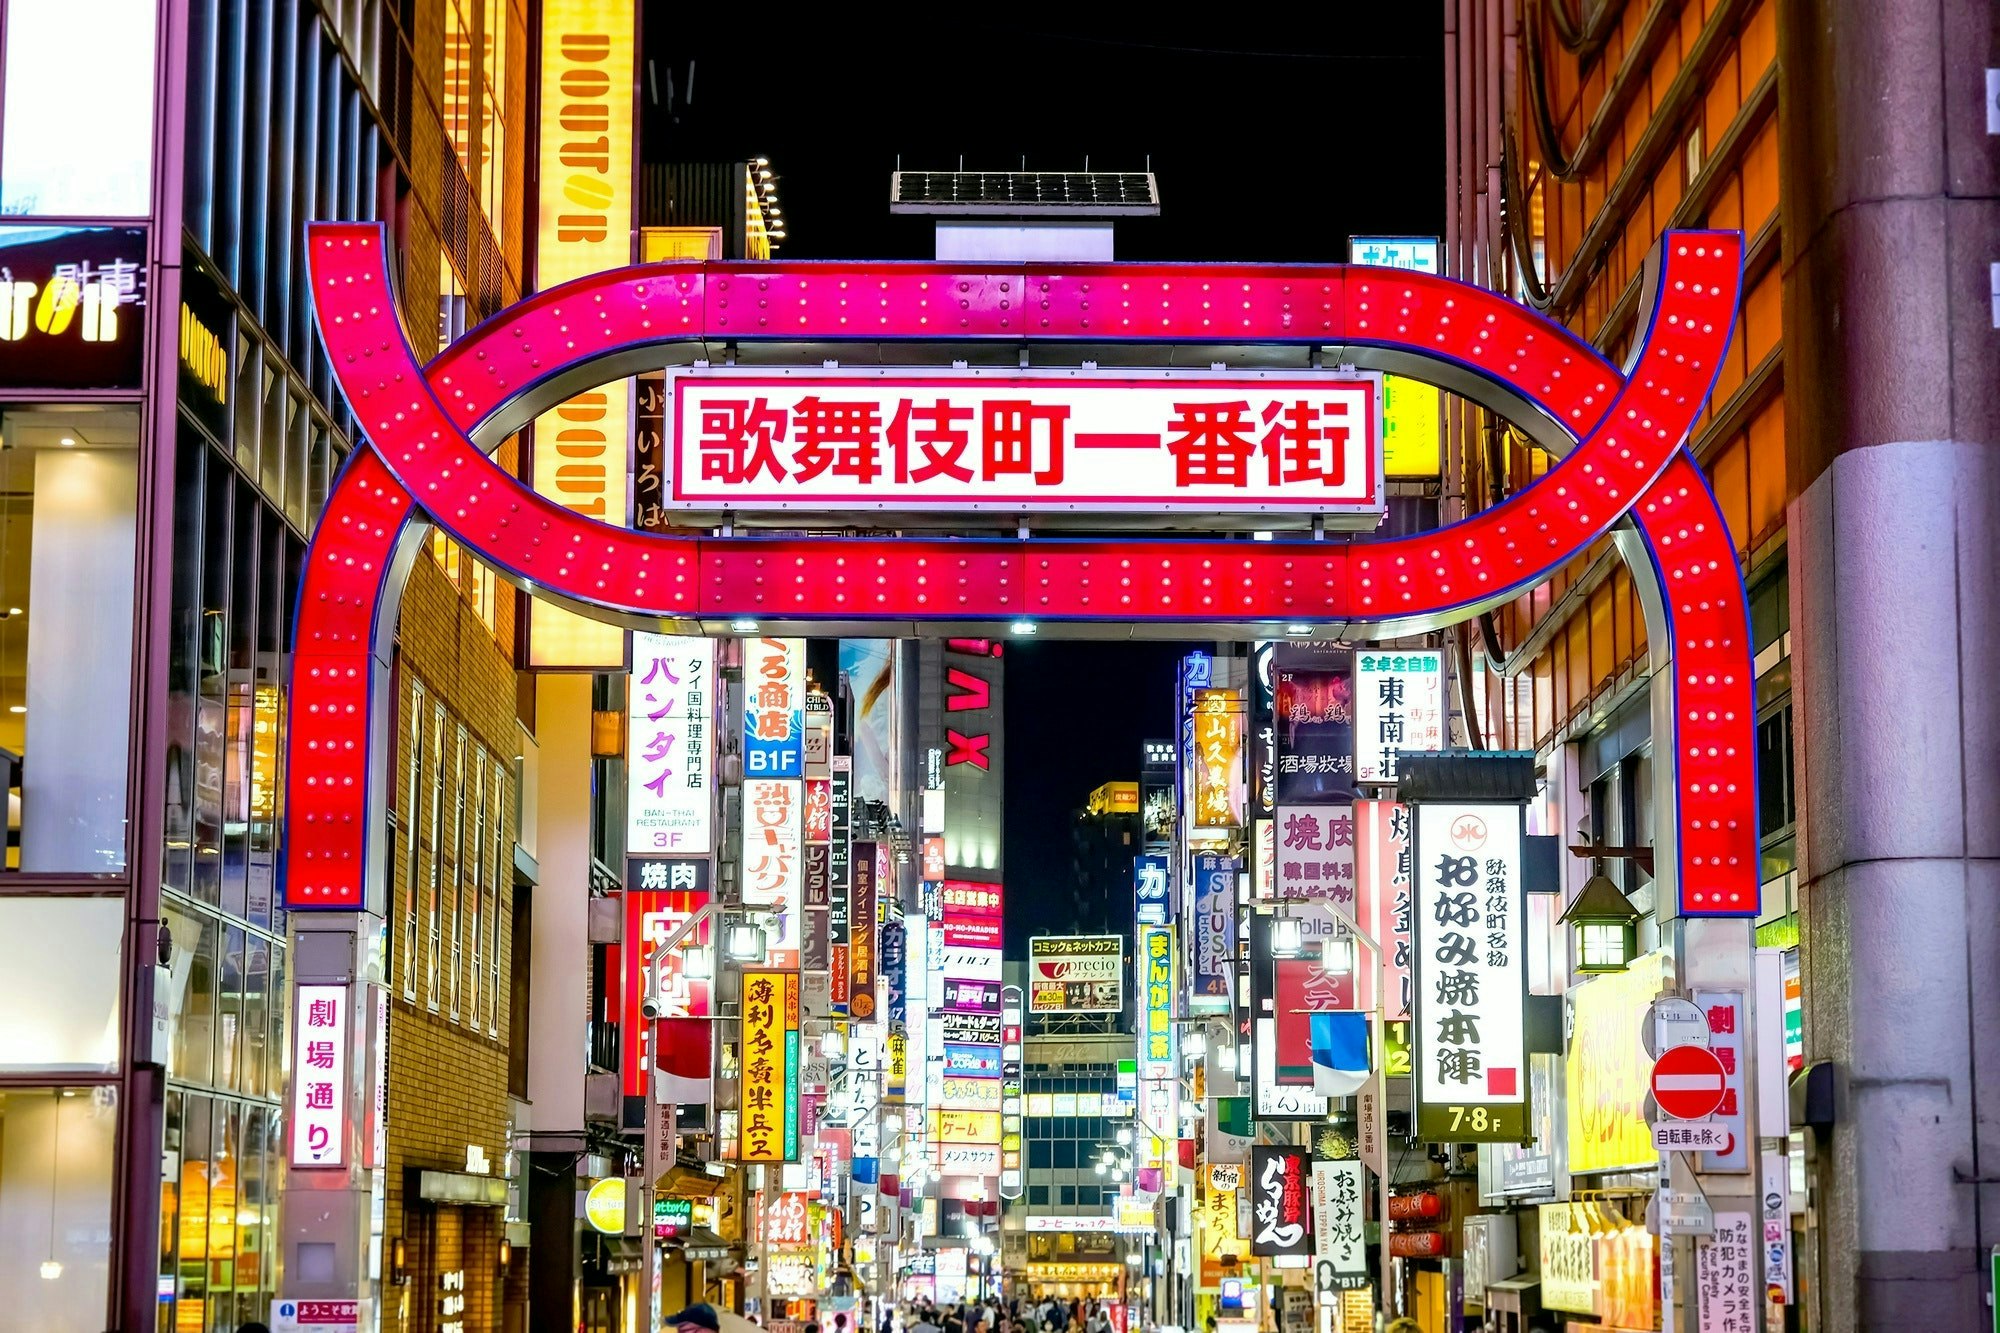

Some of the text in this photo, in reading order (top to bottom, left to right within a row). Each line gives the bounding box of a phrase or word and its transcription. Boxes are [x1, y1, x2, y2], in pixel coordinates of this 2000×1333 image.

[559, 34, 614, 242] DOUTOR
[700, 396, 1349, 487] 歌舞伎町一番街
[1281, 674, 1293, 682] 2F
[1361, 656, 1438, 672] 全卓全自動
[640, 658, 680, 798] バンタイ
[687, 659, 703, 788] タイ国料理専門店
[1379, 677, 1404, 778] 東南荘
[749, 750, 797, 771] B1F
[1361, 768, 1374, 778] 3F
[636, 819, 702, 828] RESTAURANT
[653, 832, 683, 848] 3F
[1284, 813, 1354, 856] 焼肉
[640, 862, 697, 890] 焼肉
[809, 847, 824, 903] レンタル
[857, 860, 869, 985] 個室ダイニング居酒屋
[1486, 858, 1509, 969] 歌舞伎町名物
[1034, 941, 1119, 953] コミック&ネットカフェ
[1434, 854, 1482, 1085] お好み焼本陣
[307, 999, 336, 1151] 劇場通り
[893, 1037, 904, 1075] 麻雀
[1363, 1094, 1374, 1154] 劇場通り一番街
[1657, 1128, 1722, 1146] 自転車を除く
[1212, 1170, 1238, 1185] 新宿
[1331, 1170, 1361, 1262] お好み焼き
[1709, 1247, 1717, 1267] Your
[1341, 1277, 1365, 1288] B1F
[1700, 1244, 1710, 1331] Security Camera in
[1710, 1269, 1720, 1299] Safety
